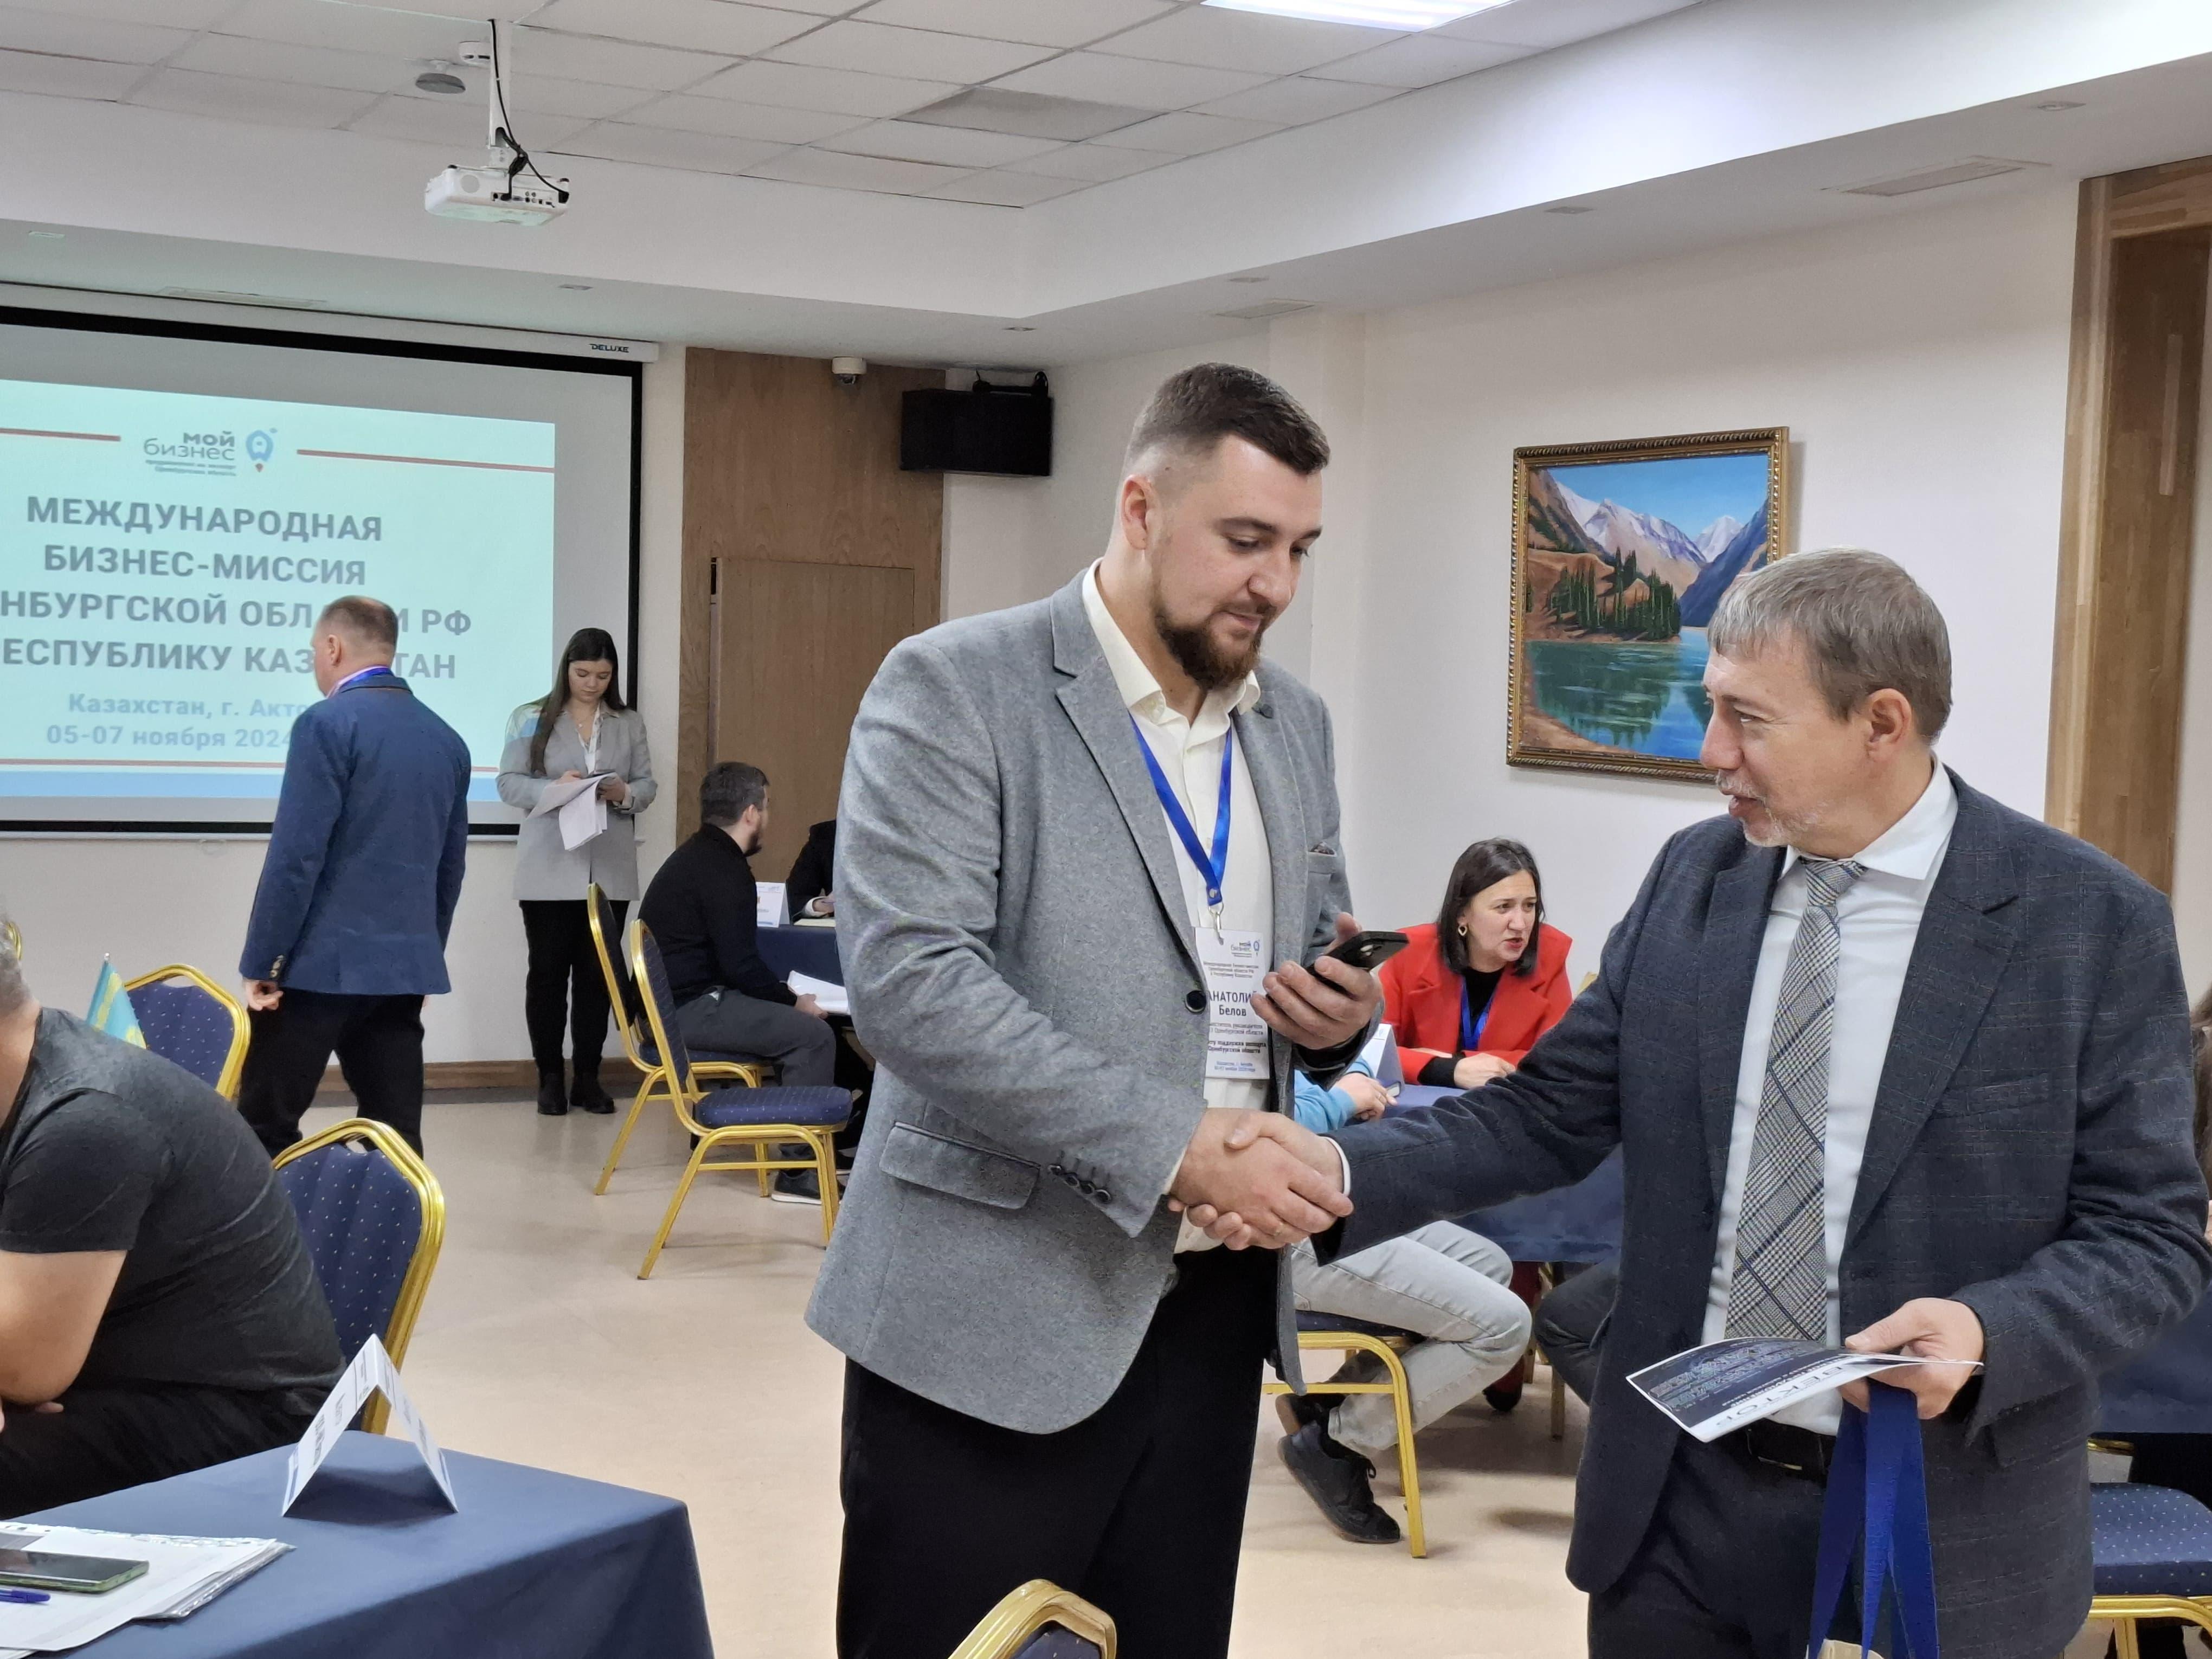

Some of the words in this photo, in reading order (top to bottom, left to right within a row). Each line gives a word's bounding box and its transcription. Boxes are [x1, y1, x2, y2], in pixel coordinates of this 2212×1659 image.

[589, 343, 629, 353] DELUXE
[143, 438, 235, 461] бизнес
[27, 496, 382, 542] МЕЖДУНАРОДНАЯ
[44, 544, 365, 586] БИЗНЕС-МИССИЯ
[1, 590, 227, 625] НБУРГСКОЙ
[239, 600, 409, 633] ОБЛИ
[421, 609, 471, 636] РФ
[3, 638, 233, 671] ЕСПУБЛИКУ
[245, 647, 456, 679] КАЗТАН
[68, 693, 213, 719] Казахстан,
[221, 702, 239, 717] г.
[47, 725, 124, 745] 05-07
[133, 726, 226, 751] ноября
[1219, 1004, 1247, 1017] Белов
